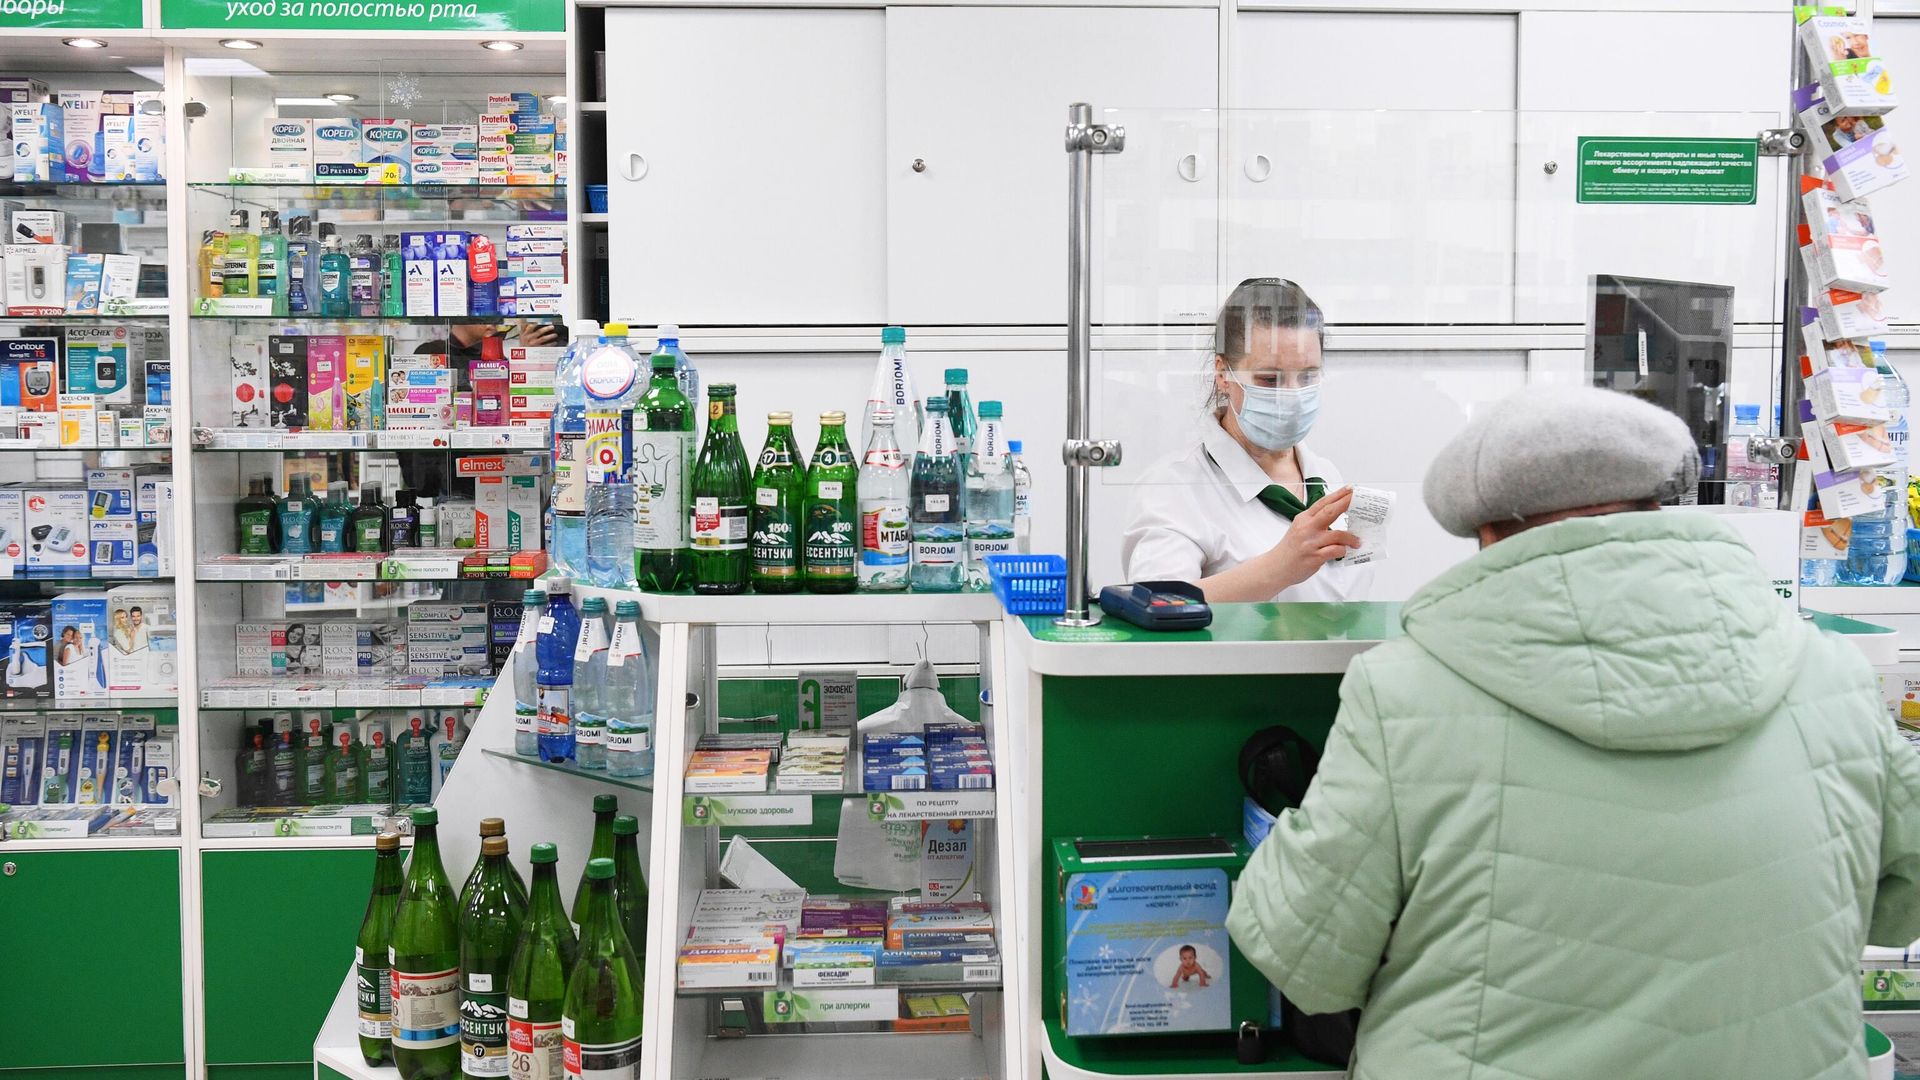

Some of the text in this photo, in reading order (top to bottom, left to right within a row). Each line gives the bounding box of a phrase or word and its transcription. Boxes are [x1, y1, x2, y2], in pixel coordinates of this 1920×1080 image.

[225, 0, 477, 21] уход за полостью рта
[1817, 106, 1830, 116] Co
[481, 115, 509, 124] Protefix
[273, 125, 301, 133] КОРЕГА
[321, 129, 354, 138] КОРЕГА
[369, 128, 403, 138] КОРЕГА
[480, 136, 505, 144] Protefix
[1651, 151, 1689, 159] препараты
[481, 156, 505, 164] Protefix
[8, 342, 45, 351] Contour
[34, 350, 46, 358] TS
[513, 350, 524, 358] SPLAT
[513, 374, 525, 382] SPLAT
[894, 358, 905, 406] BORJOMI
[513, 398, 525, 406] SPLAT
[934, 419, 942, 456] BORJOMI
[824, 453, 832, 463] 4
[462, 460, 502, 471] elmex
[806, 546, 854, 558] ЕССЕНТУКИ
[919, 545, 956, 554] BORJOMI
[974, 543, 1009, 552] BORJOMI
[754, 547, 793, 559] СЕНТУКИ
[1775, 588, 1793, 599] ТЬ
[823, 685, 853, 694] ЭФФЕКС
[607, 736, 632, 745] ORJOMI
[727, 807, 794, 816] мужское здоровье
[898, 810, 957, 819] ЛЕКАРСТВЕННЫЙ
[927, 839, 967, 854] Дезал
[1194, 882, 1216, 891] ФОНД
[819, 1002, 870, 1011] при аллергии
[475, 1047, 483, 1056] 17
[511, 1051, 531, 1072] 26
